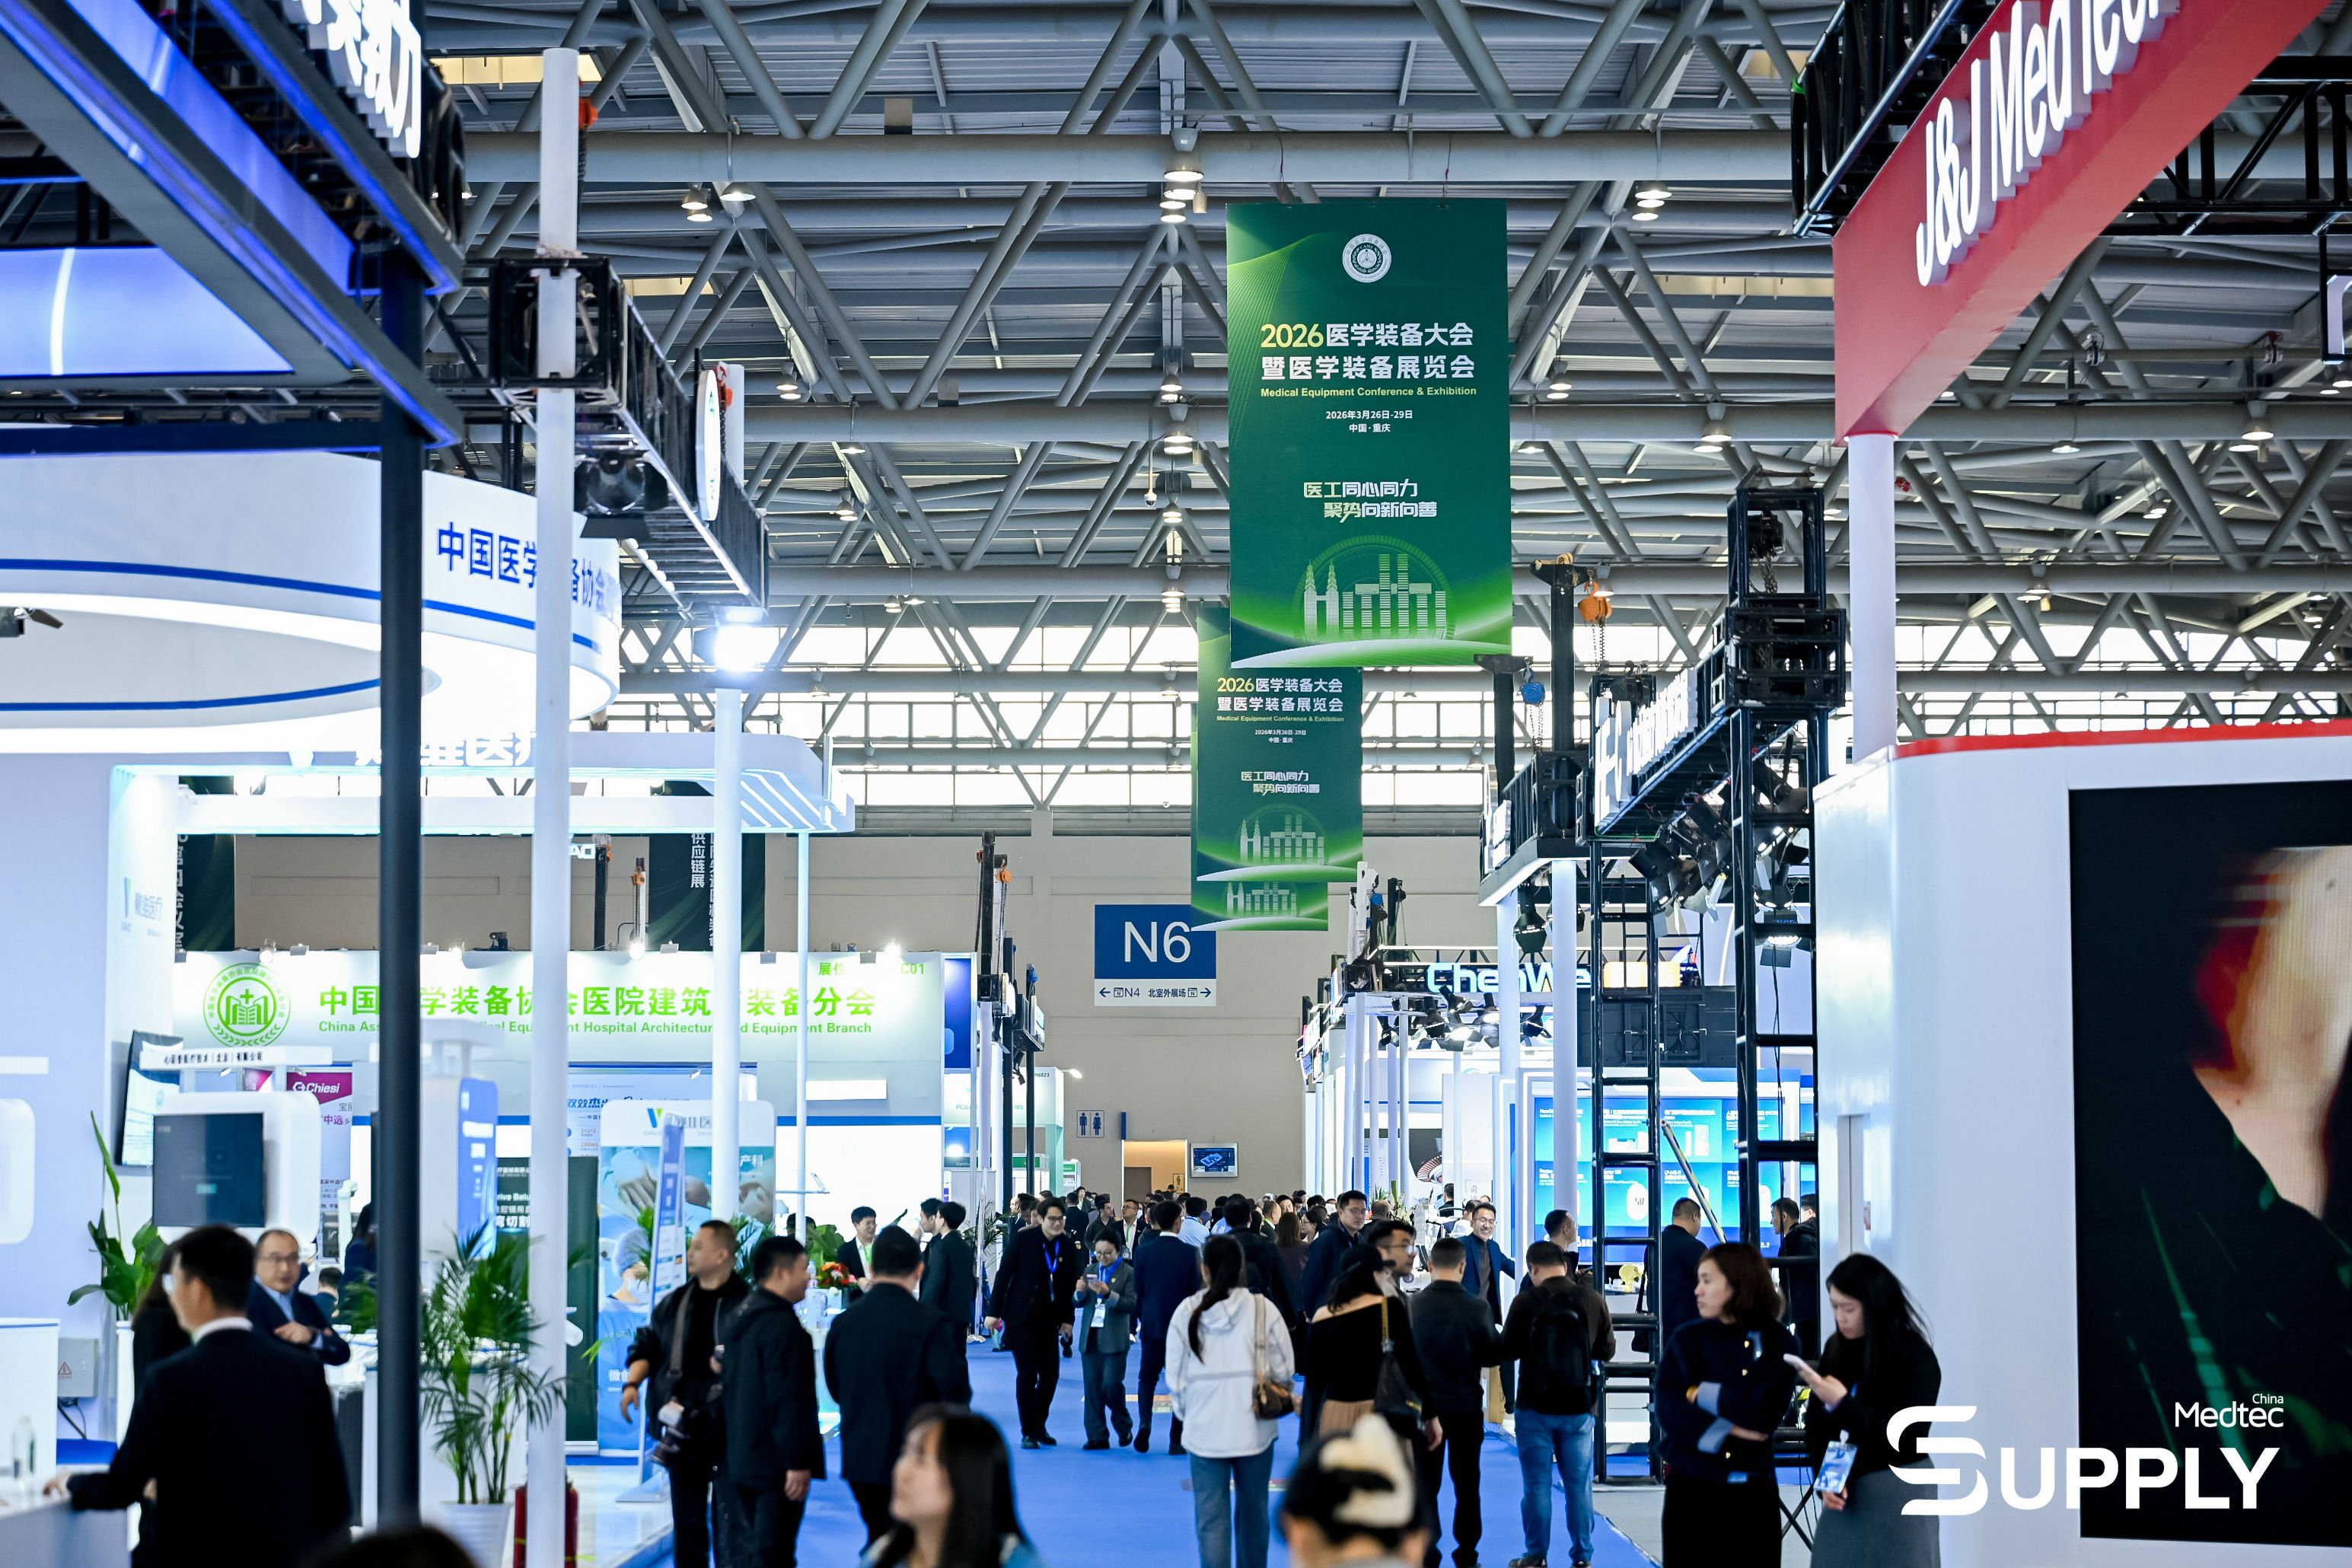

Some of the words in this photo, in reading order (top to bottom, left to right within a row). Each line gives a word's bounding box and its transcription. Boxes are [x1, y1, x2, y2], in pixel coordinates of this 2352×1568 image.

[1916, 58, 1981, 286] J&J
[1260, 322, 1474, 348] 2026医学装备大会
[1261, 355, 1474, 380] 暨医学装备展览会
[1260, 388, 1299, 397] Medical
[1302, 388, 1354, 398] Equipment
[1357, 387, 1413, 397] Conference
[1417, 387, 1424, 396] &
[1426, 387, 1477, 396] Exhibition
[1325, 410, 1413, 419] 2026年3月26日-29日
[1303, 478, 1418, 498] 医工同心同力
[1324, 502, 1437, 523] 聚势向新向善
[1217, 696, 1343, 712] 暨医学装备展览会
[1241, 770, 1308, 781] 医工同心同力
[1124, 921, 1191, 963] N6
[1124, 987, 1140, 997] N4
[1148, 988, 1186, 998] 北室外展场
[319, 1021, 355, 1032] China
[584, 1021, 637, 1034] Hospital
[641, 1021, 712, 1033] Architectur
[827, 1022, 872, 1033] Branch
[306, 1082, 340, 1093] Chiesi
